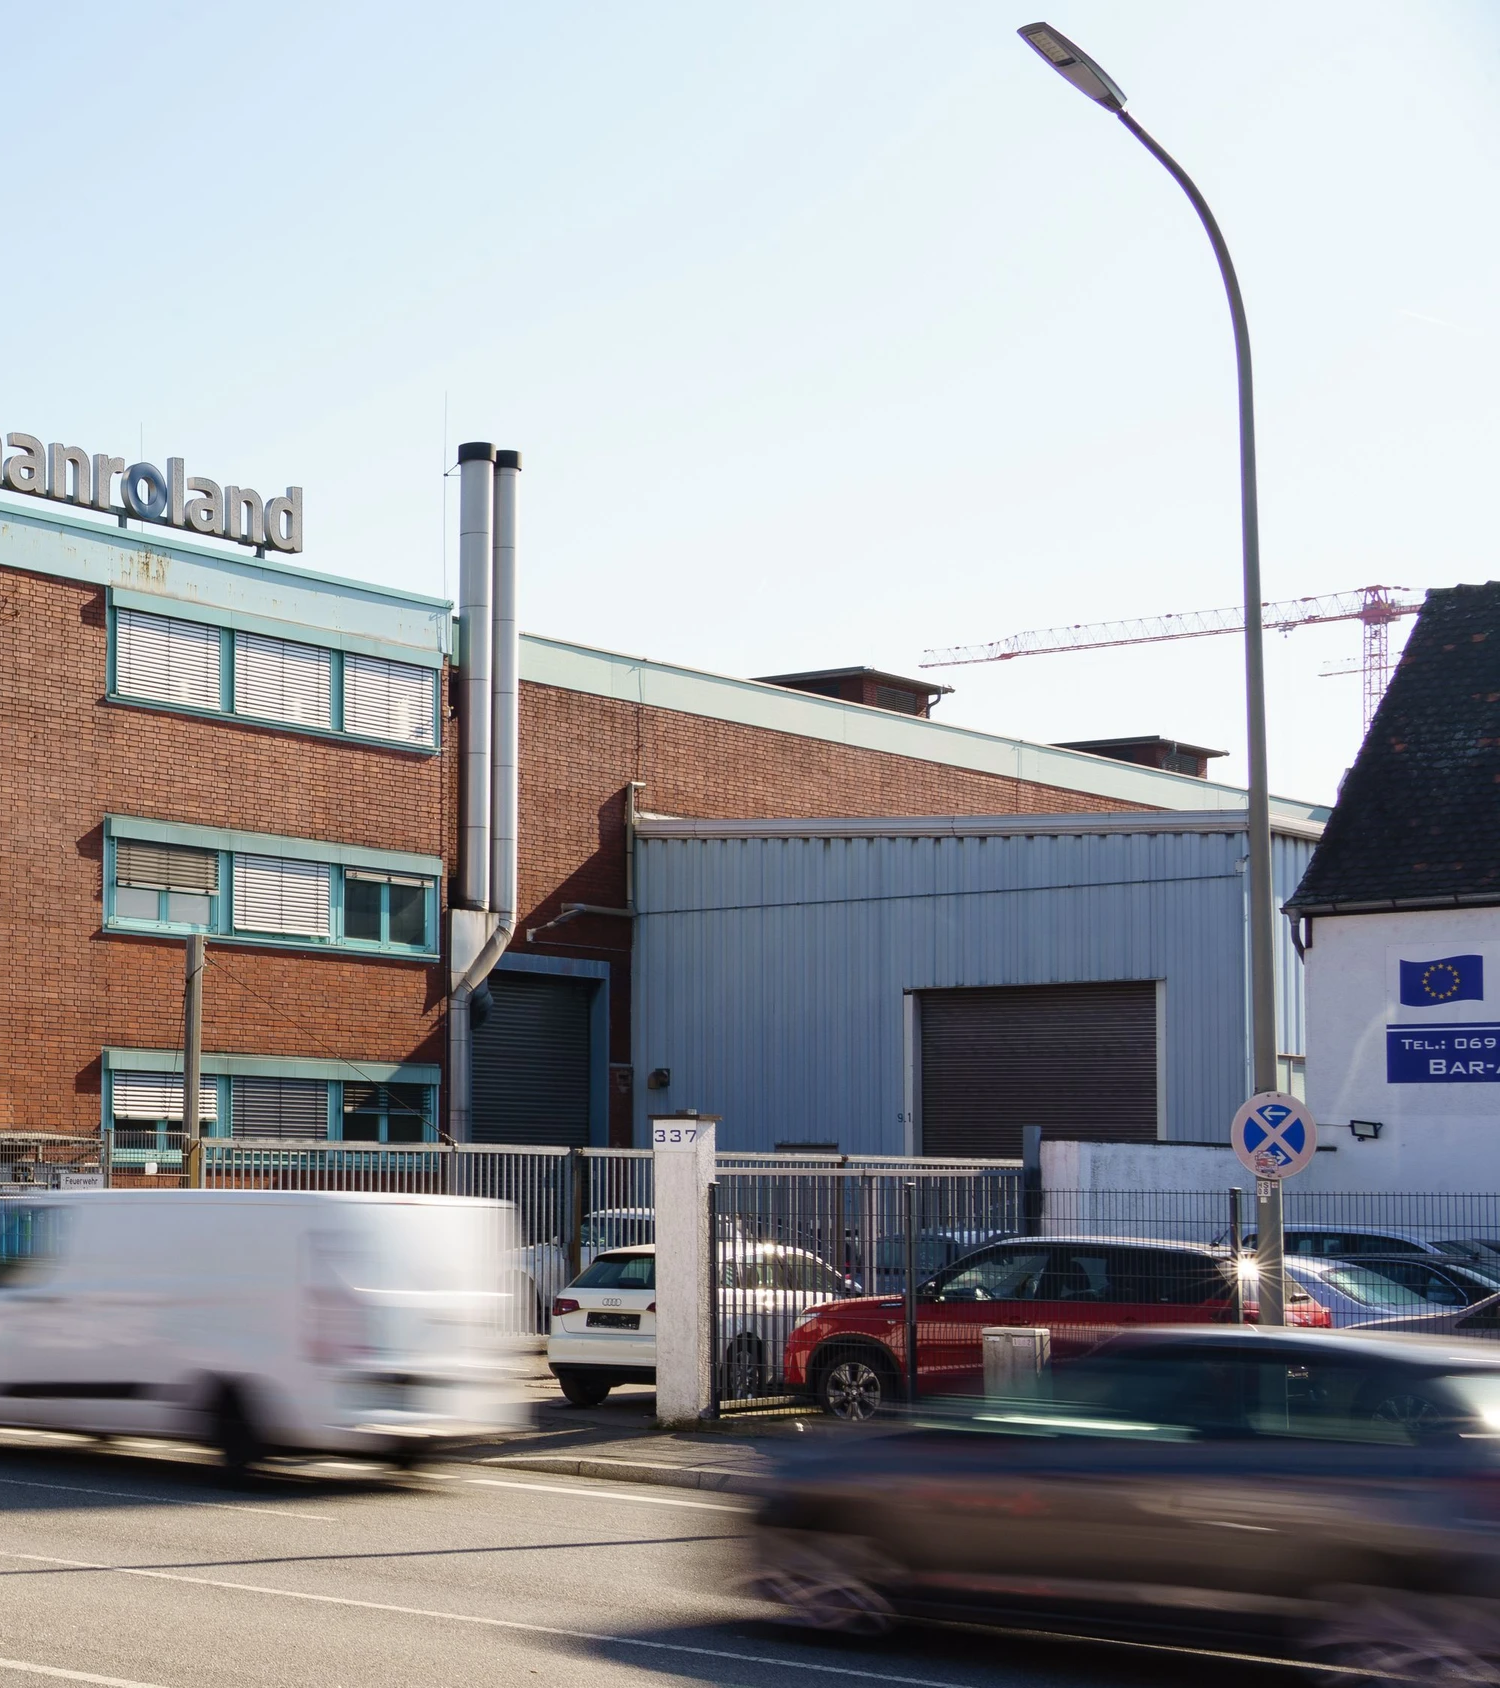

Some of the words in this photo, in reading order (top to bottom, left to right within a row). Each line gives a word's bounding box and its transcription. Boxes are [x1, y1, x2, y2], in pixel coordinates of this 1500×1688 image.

[1454, 1037, 1497, 1049] 069
[1429, 1059, 1500, 1075] BAR-
[654, 1129, 698, 1143] 337
[64, 1176, 99, 1186] Feuerwehr
